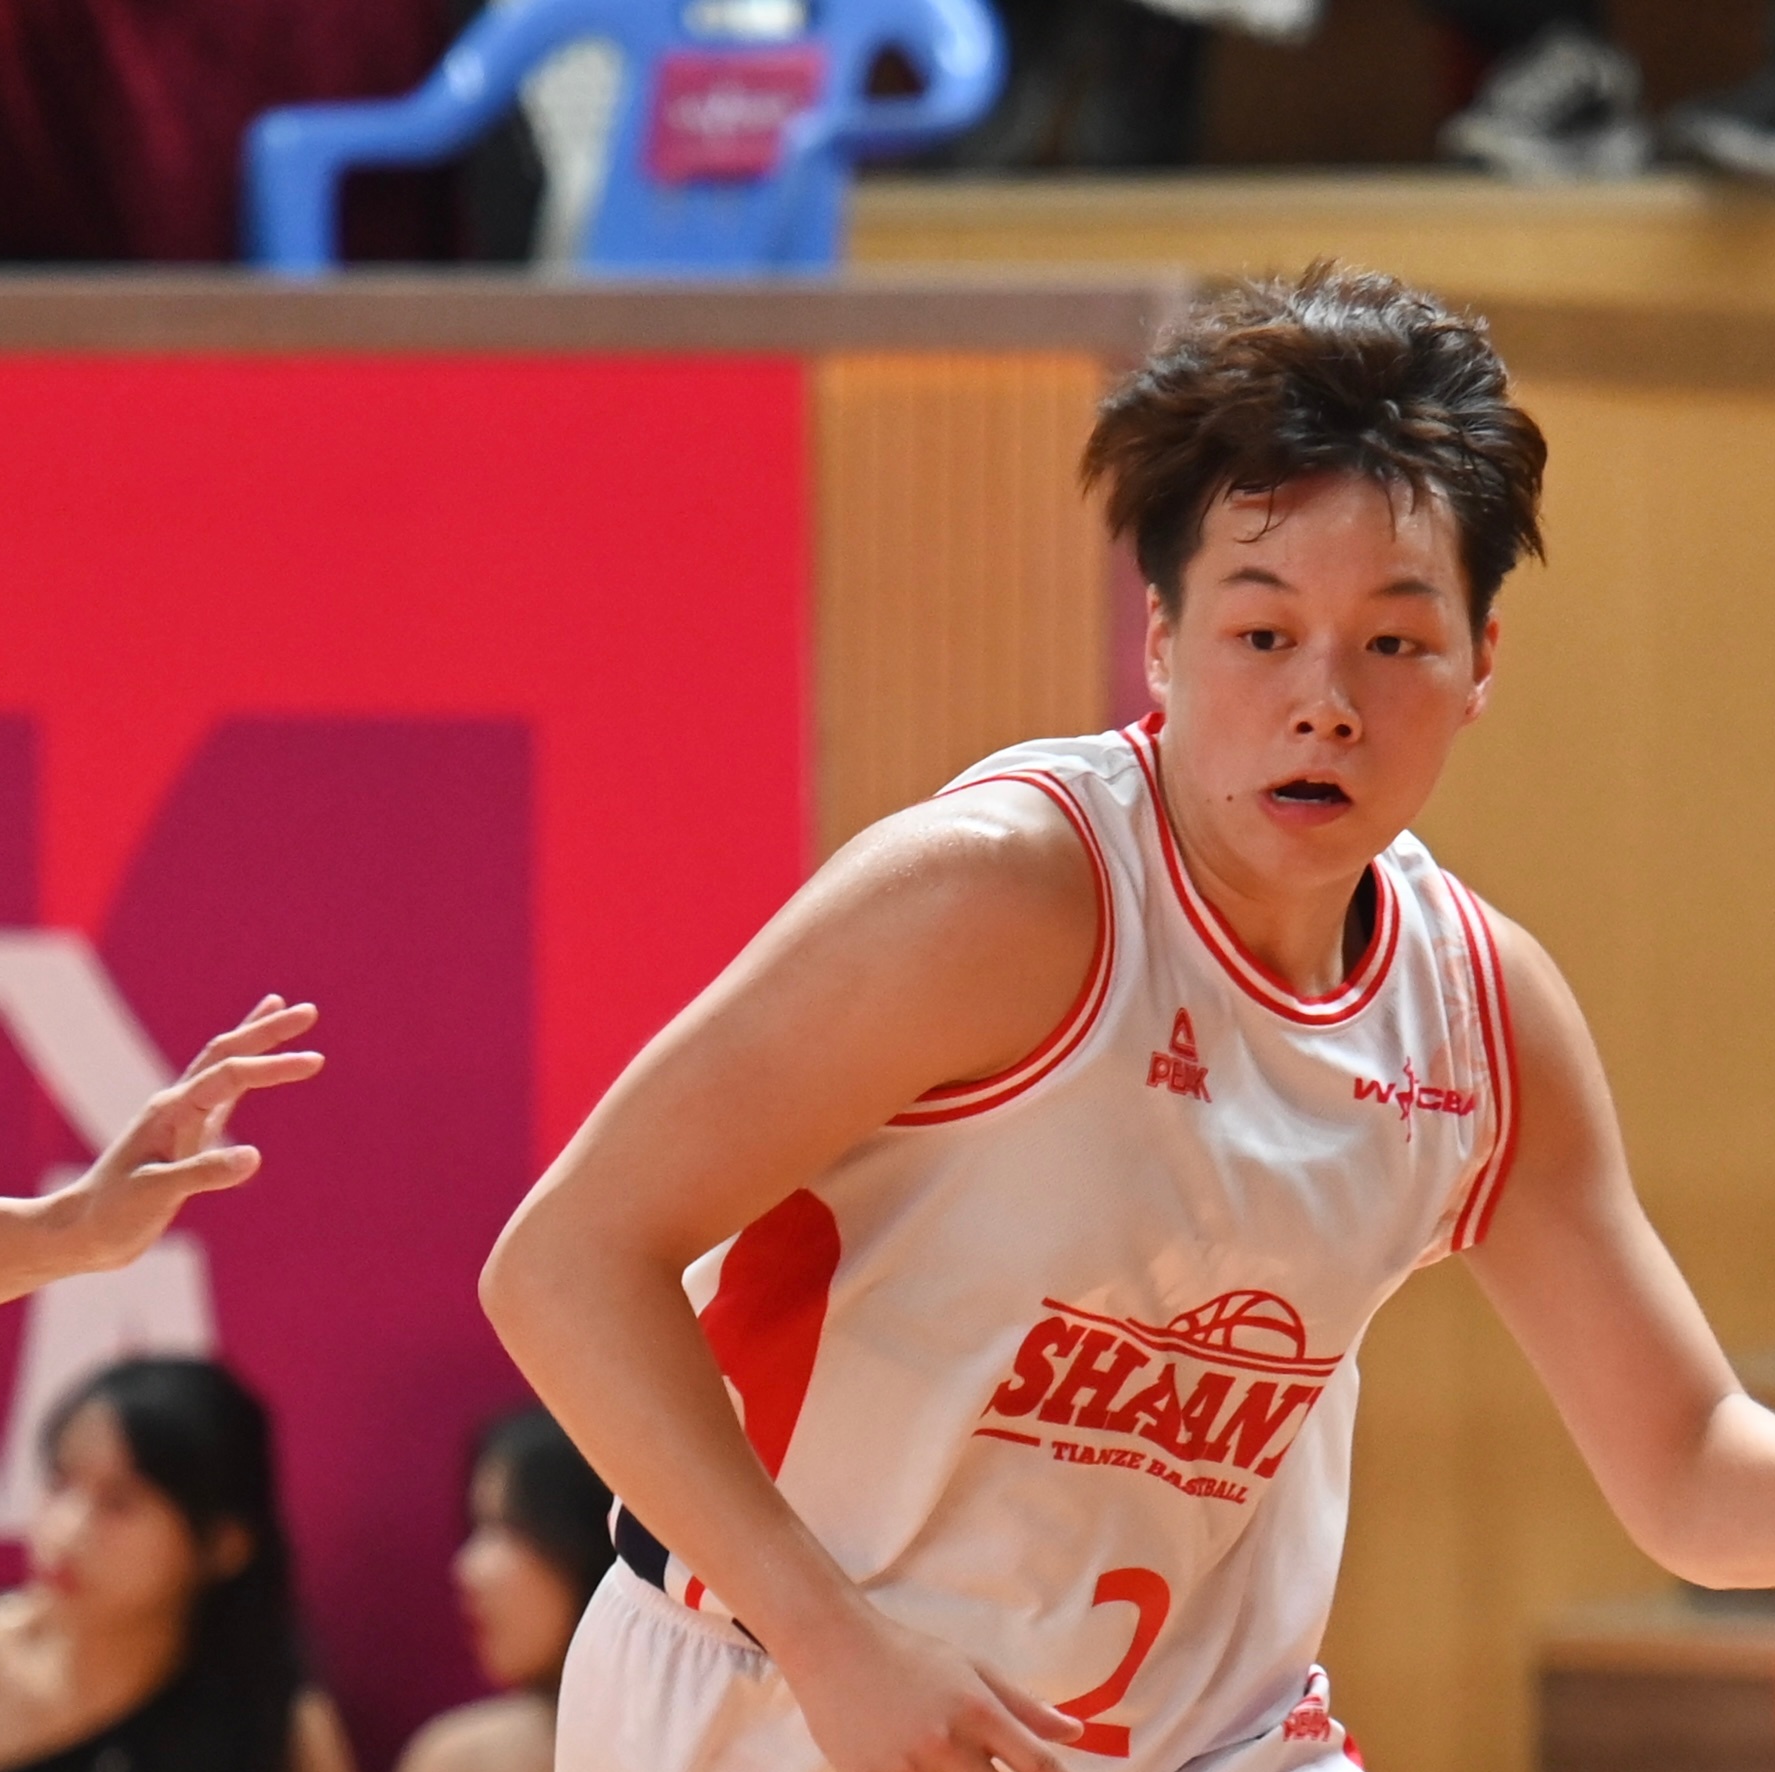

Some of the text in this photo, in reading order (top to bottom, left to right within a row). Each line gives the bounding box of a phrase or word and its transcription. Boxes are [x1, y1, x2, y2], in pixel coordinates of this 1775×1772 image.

[1052, 1441, 1248, 1504] TIANZE BASTBALL
[1053, 1567, 1171, 1758] 2
